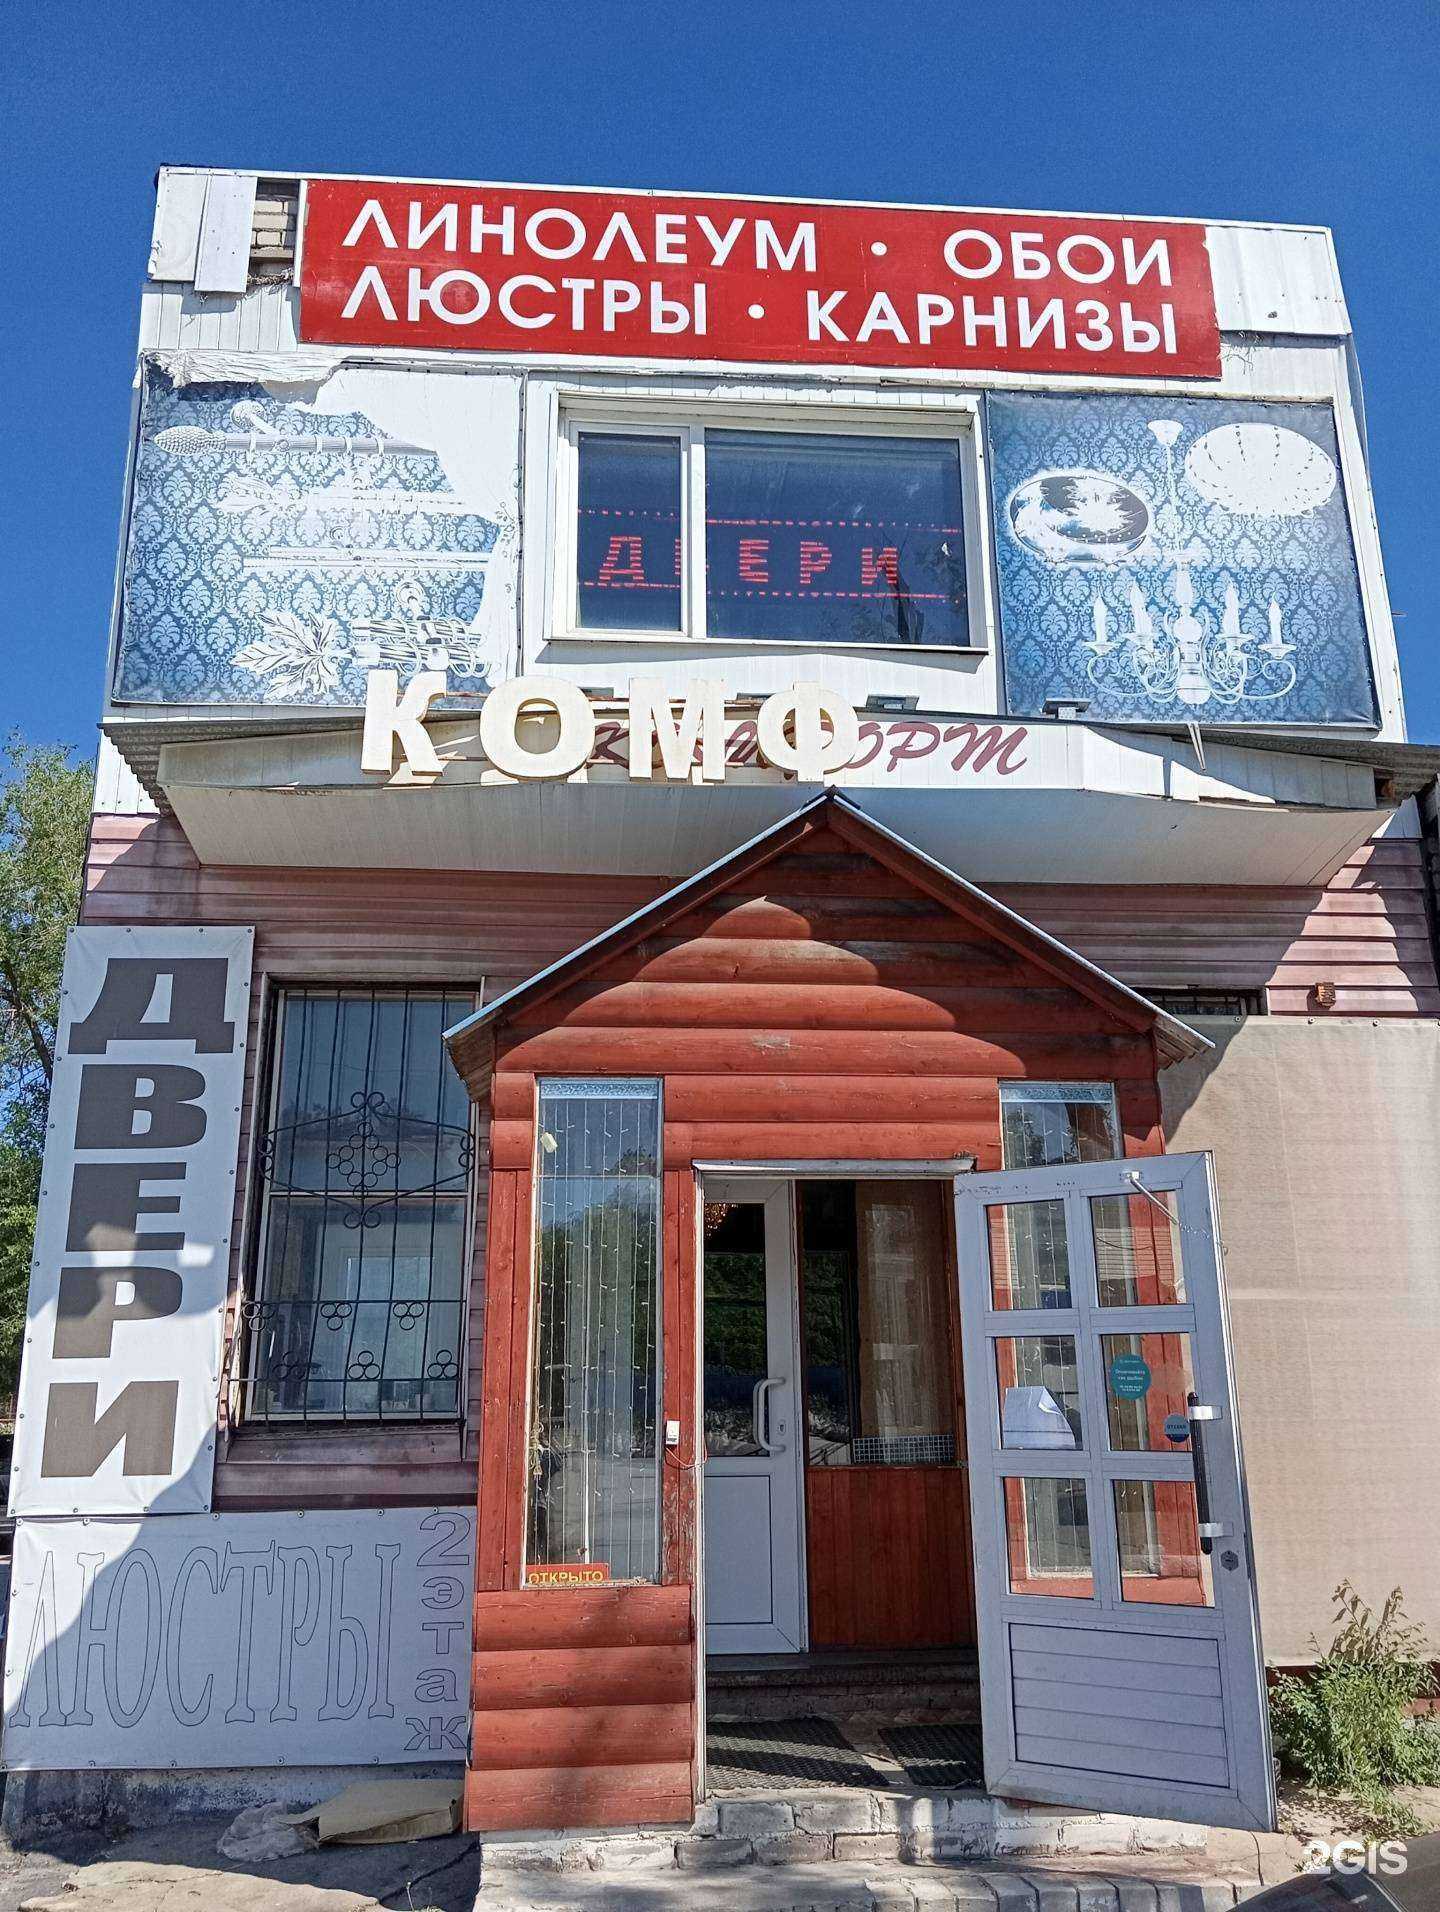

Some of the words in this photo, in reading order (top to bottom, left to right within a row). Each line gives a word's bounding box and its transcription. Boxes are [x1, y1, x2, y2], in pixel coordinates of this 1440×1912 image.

[342, 199, 817, 272] ЛИНОЛЕУМ
[943, 229, 1172, 287] ОБОИ
[341, 265, 707, 335] ЛЮСТРЫ
[807, 290, 1177, 354] КАРНИЗЫ
[599, 536, 897, 585] ДЕРИ
[361, 670, 859, 783] КОМФ
[41, 958, 234, 1477] ДВЕРИ
[417, 1512, 469, 1567] 2
[529, 1571, 603, 1584] ОТКРЫТО
[9, 1540, 401, 1729] ЛЮСТРЫ
